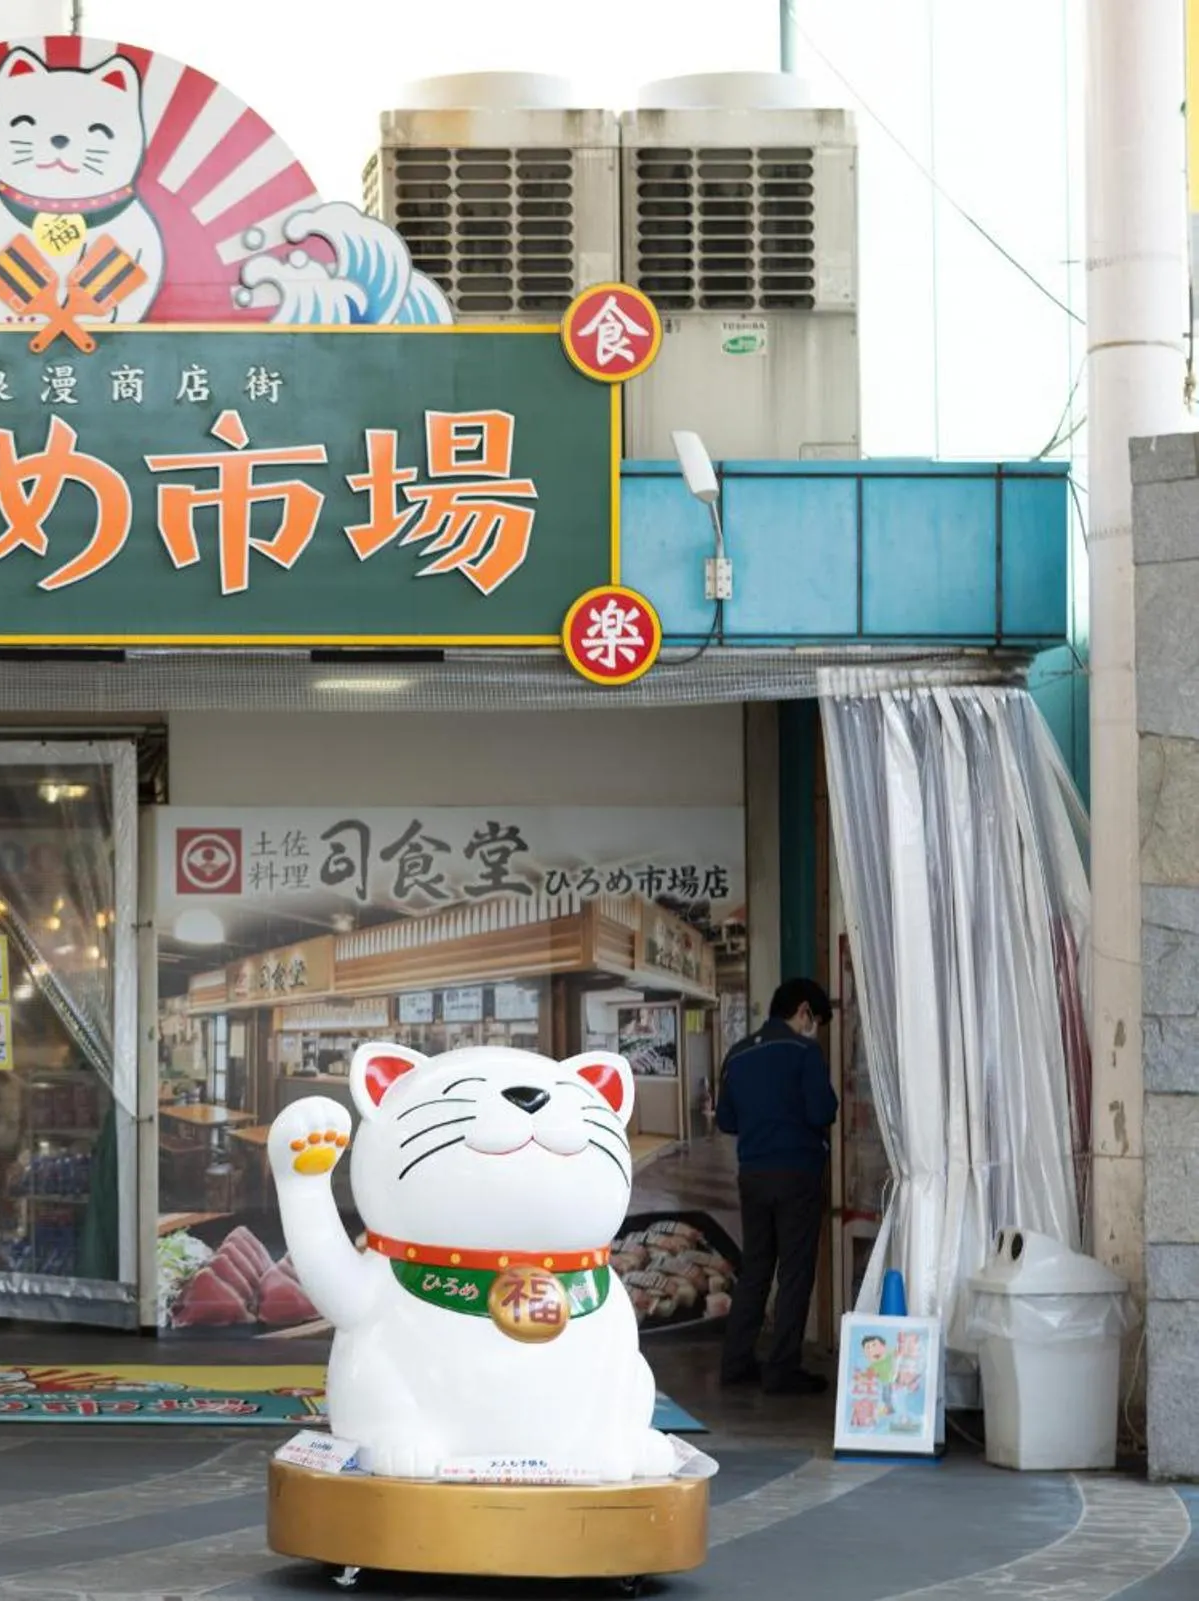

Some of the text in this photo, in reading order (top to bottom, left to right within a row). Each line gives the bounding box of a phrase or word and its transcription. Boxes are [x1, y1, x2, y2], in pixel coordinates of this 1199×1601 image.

[42, 214, 80, 251] 福
[577, 295, 650, 366] 食
[580, 599, 646, 669] 楽
[251, 830, 310, 857] 土佐
[319, 818, 533, 901] 司食堂
[248, 861, 310, 891] 料理
[544, 865, 729, 899] ひろめ市場店
[421, 1273, 480, 1301] ひろめ
[501, 1271, 562, 1325] 福
